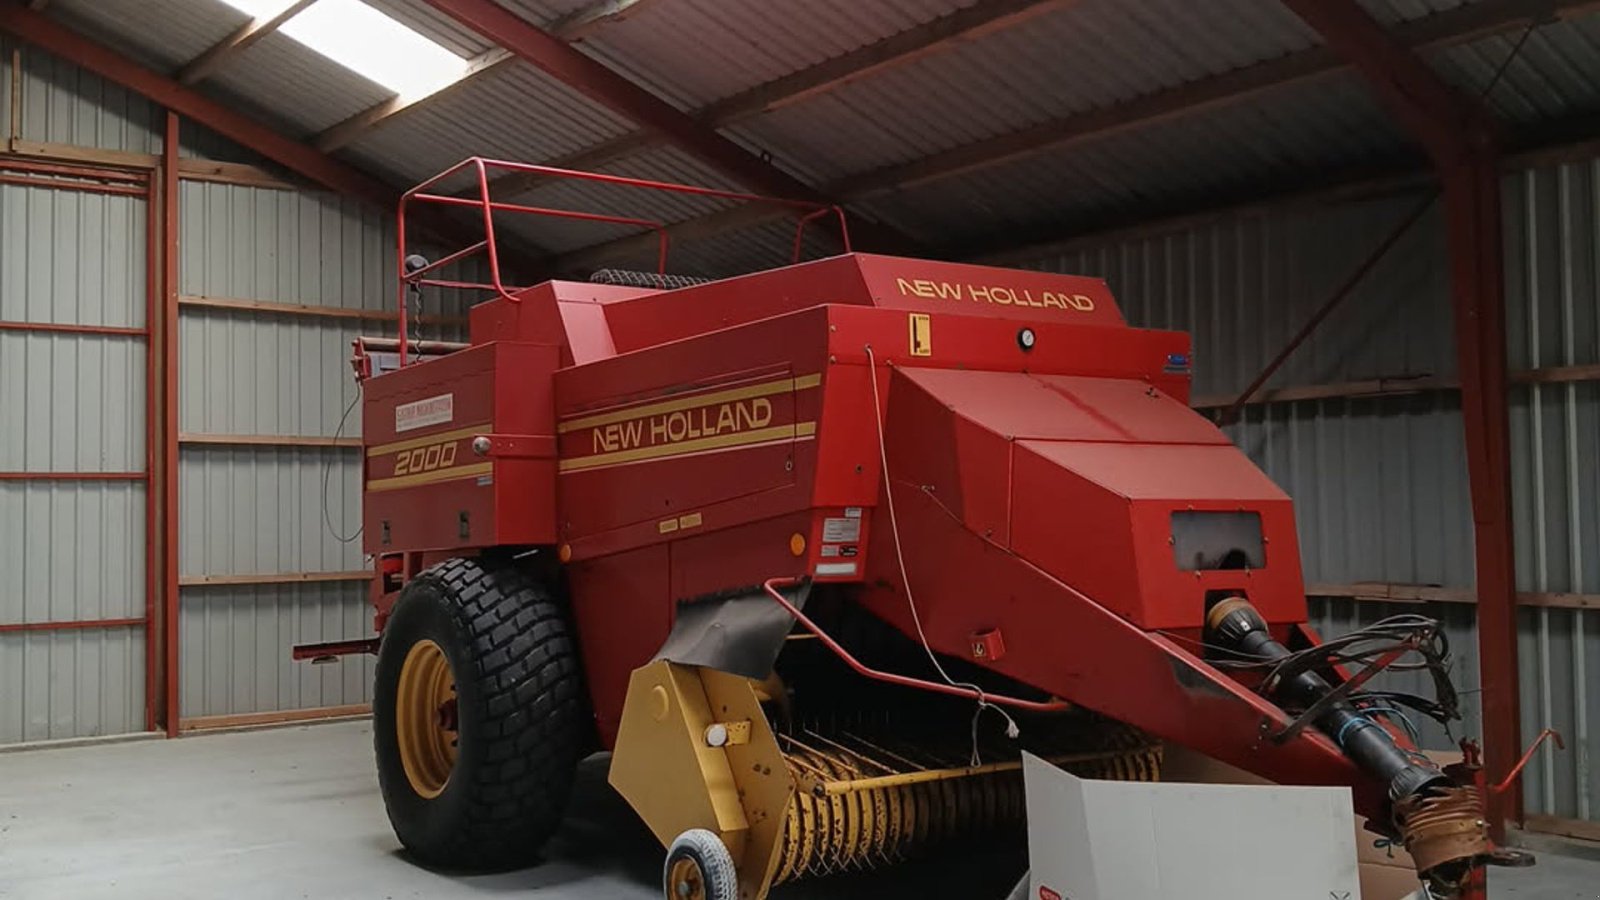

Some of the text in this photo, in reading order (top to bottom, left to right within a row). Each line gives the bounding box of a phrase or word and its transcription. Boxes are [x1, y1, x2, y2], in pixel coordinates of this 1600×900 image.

[897, 278, 1095, 311] NEW HOLLAND
[593, 398, 772, 453] NEW HOLLAND
[394, 441, 458, 476] 2000
